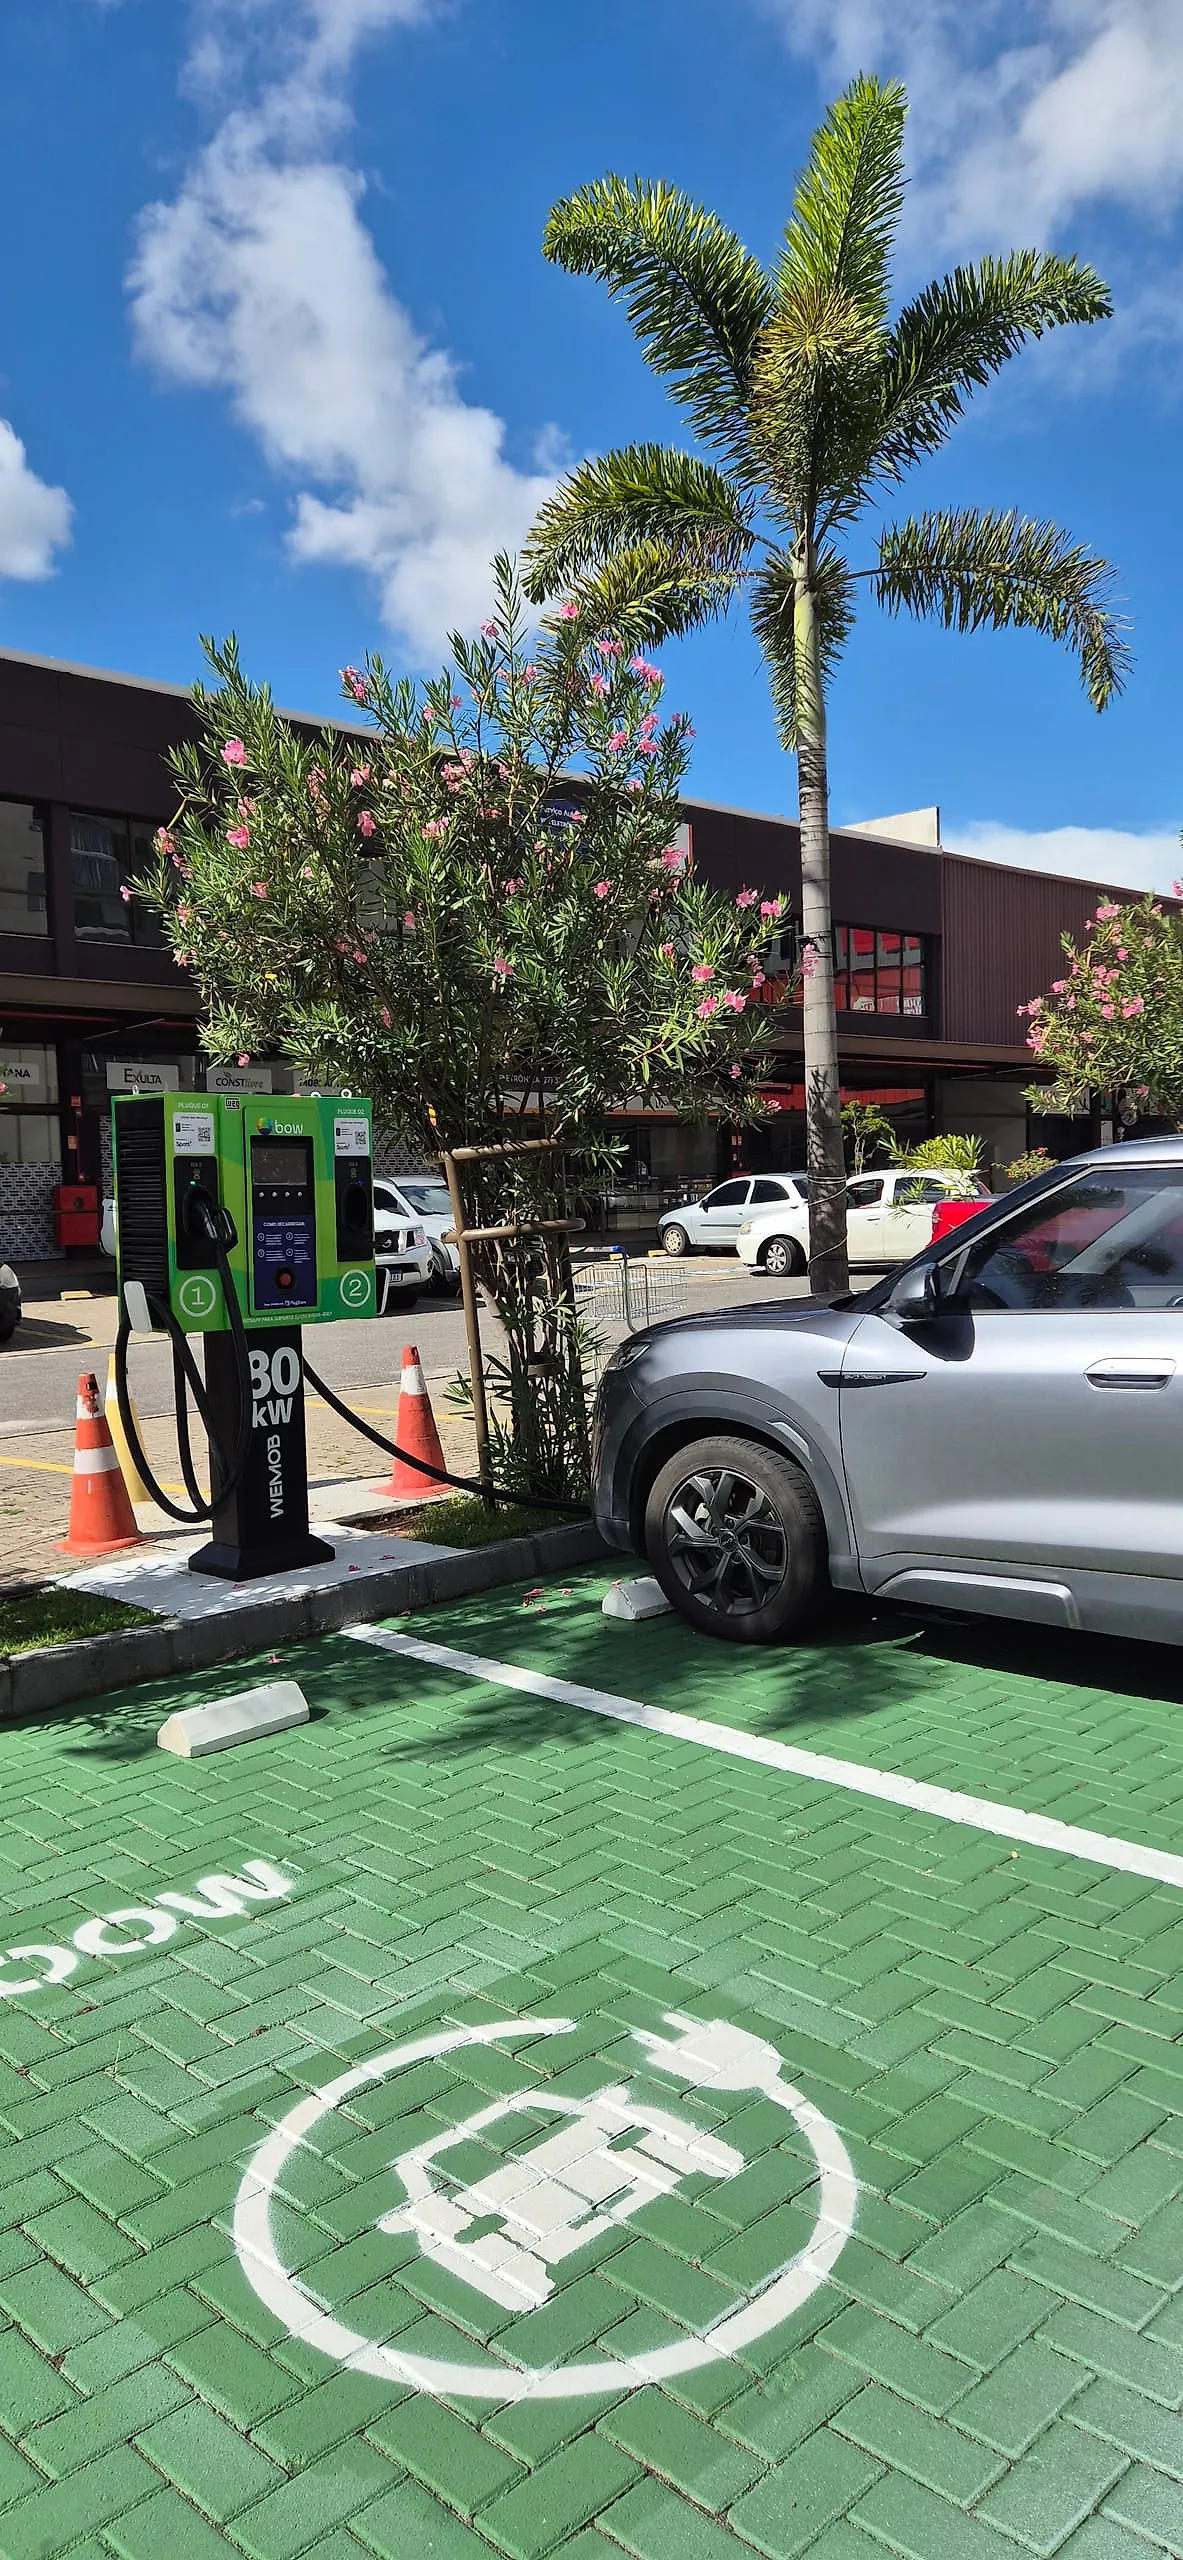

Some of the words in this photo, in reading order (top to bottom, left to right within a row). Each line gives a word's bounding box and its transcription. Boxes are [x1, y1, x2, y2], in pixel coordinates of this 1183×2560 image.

[275, 1120, 304, 1134] bow
[191, 1287, 205, 1306] 1
[348, 1279, 362, 1298] 2
[248, 1346, 300, 1399] 80
[252, 1397, 293, 1428] kW
[267, 1434, 284, 1519] WEMOB
